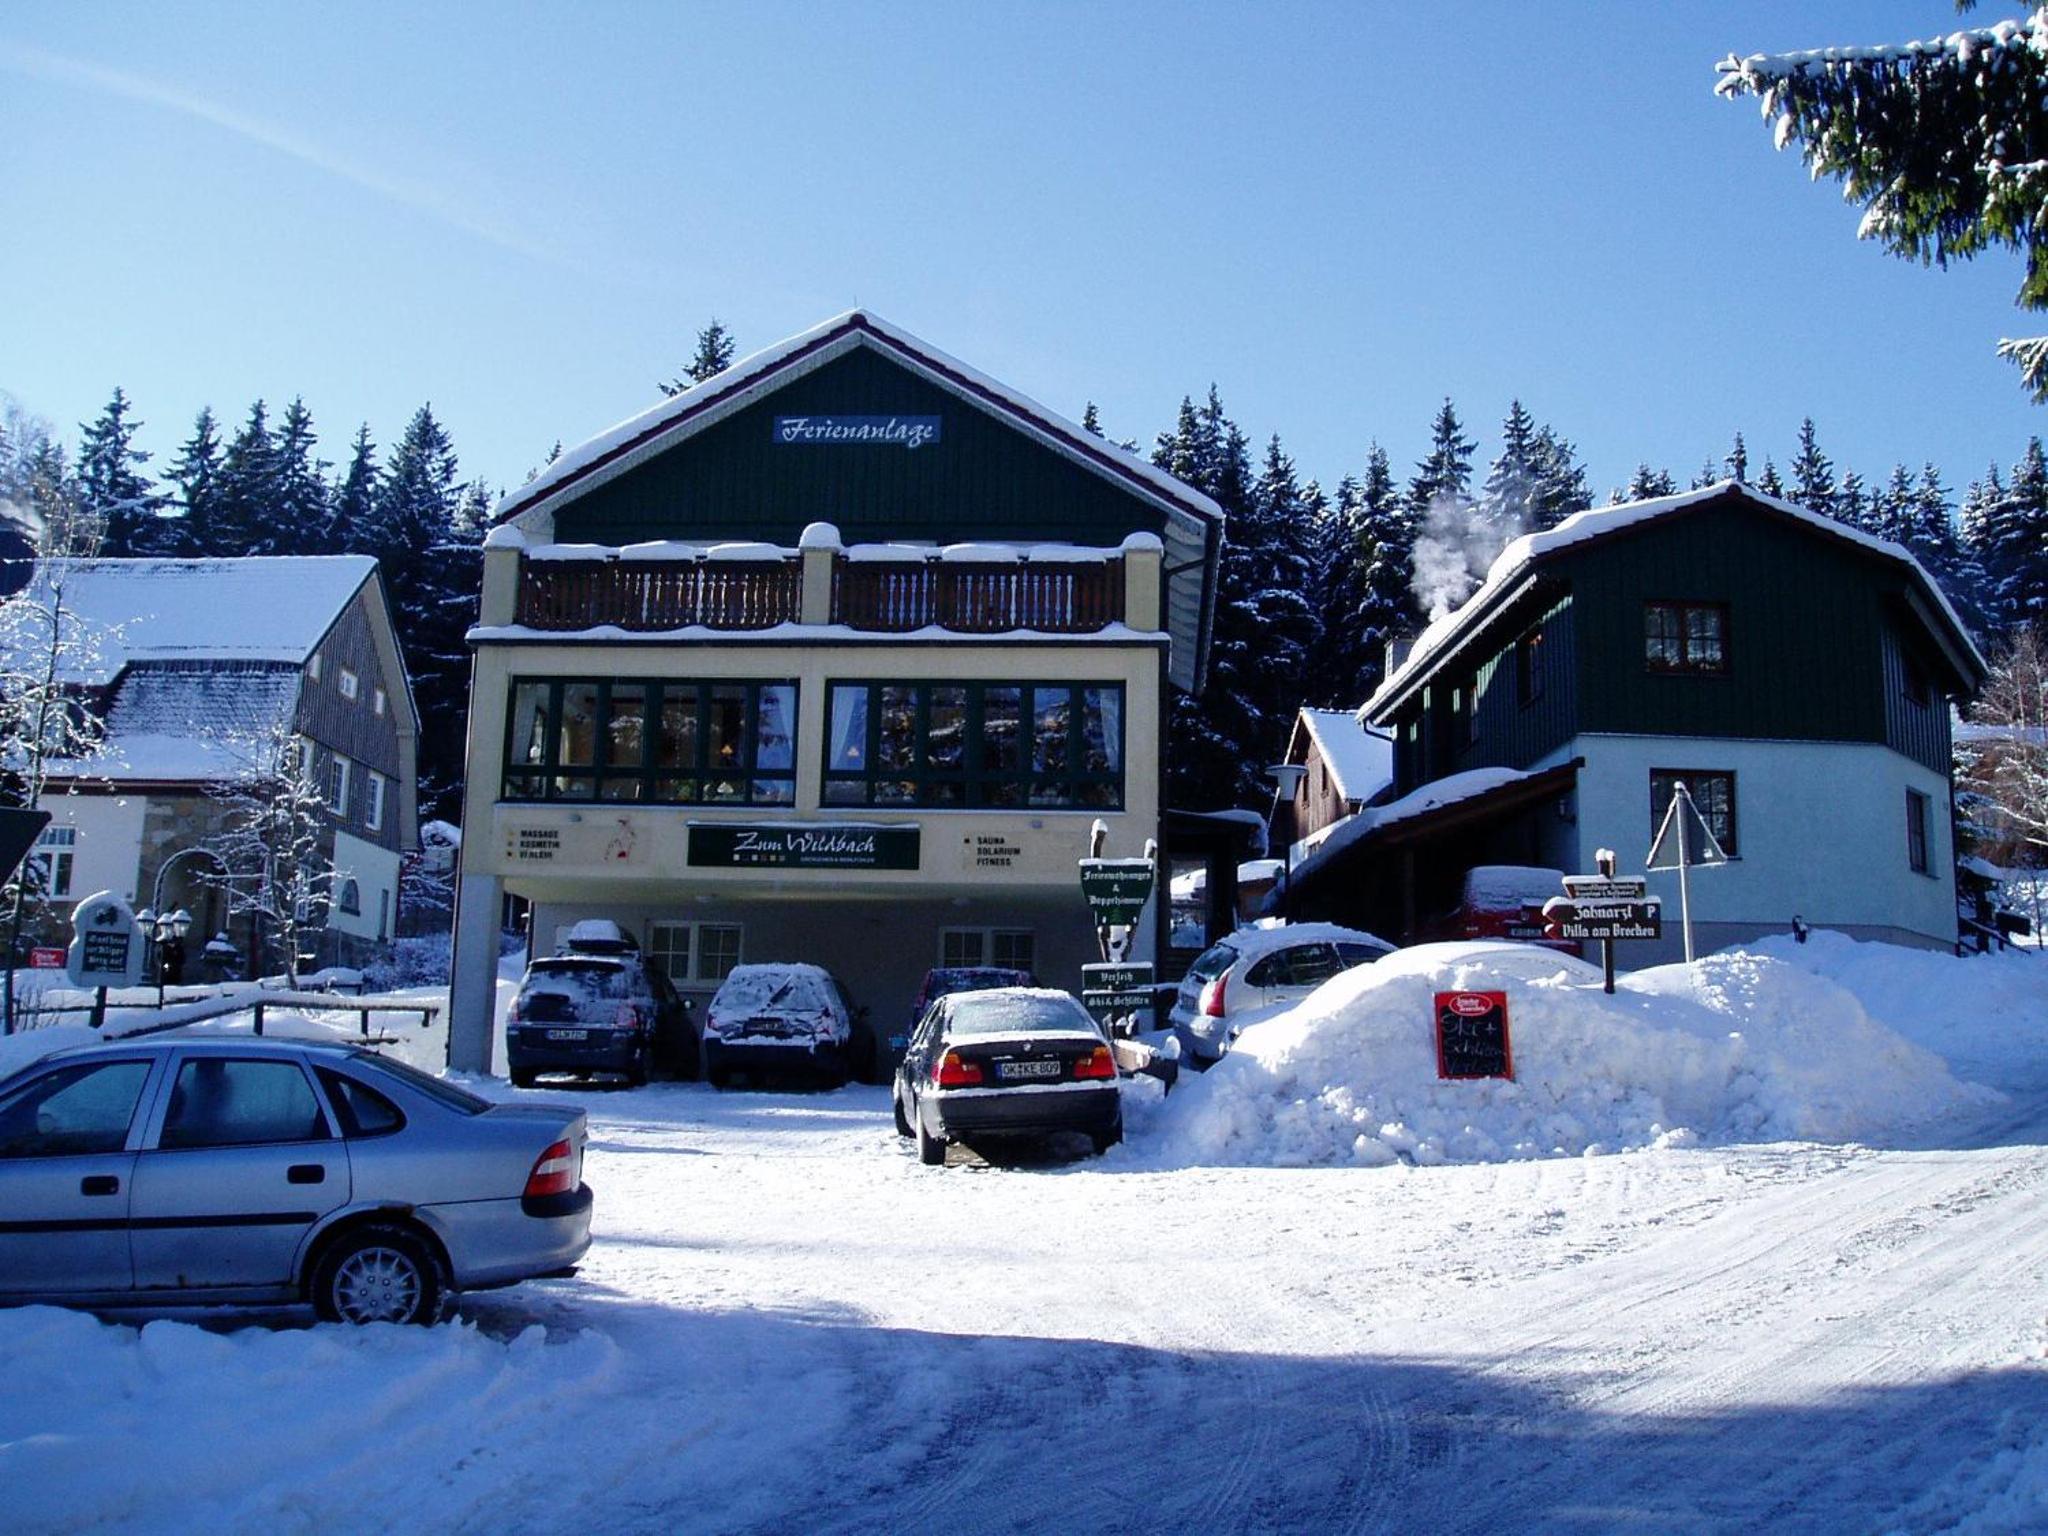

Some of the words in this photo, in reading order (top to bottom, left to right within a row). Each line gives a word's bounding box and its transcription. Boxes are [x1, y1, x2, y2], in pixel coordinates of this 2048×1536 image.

[782, 418, 933, 447] Ferienanlage
[733, 831, 782, 851] Zum
[787, 831, 875, 853] Wildbach
[977, 836, 1005, 845] SAUNA
[977, 847, 1021, 855] SOLARIUM
[977, 857, 1011, 866] FITNESS
[1647, 905, 1656, 918] P
[1562, 923, 1589, 938] Villa
[1592, 927, 1610, 937] am
[1612, 922, 1655, 937] Brocken
